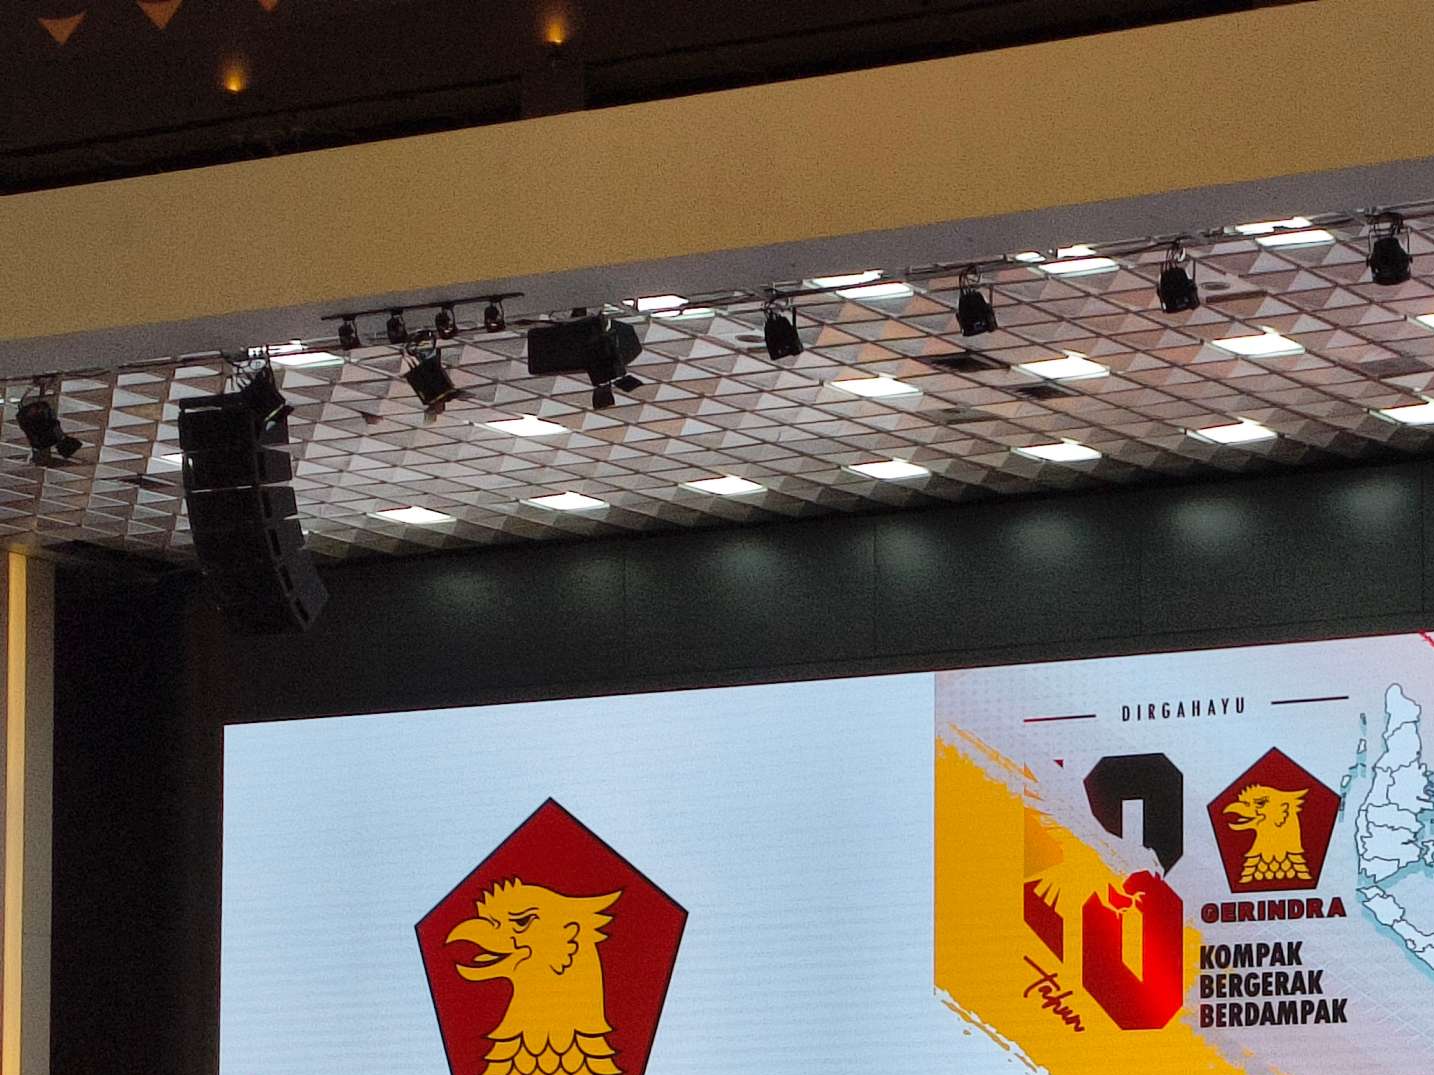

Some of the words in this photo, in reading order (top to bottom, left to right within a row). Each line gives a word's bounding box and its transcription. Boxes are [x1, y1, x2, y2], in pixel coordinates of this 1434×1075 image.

[1121, 696, 1246, 723] DIRGAHAYU
[1200, 896, 1347, 924] GERINDRA
[1200, 941, 1303, 970] KOMPAK
[1200, 969, 1324, 999] BERGERAK
[1200, 998, 1348, 1028] BERDAMPAK
